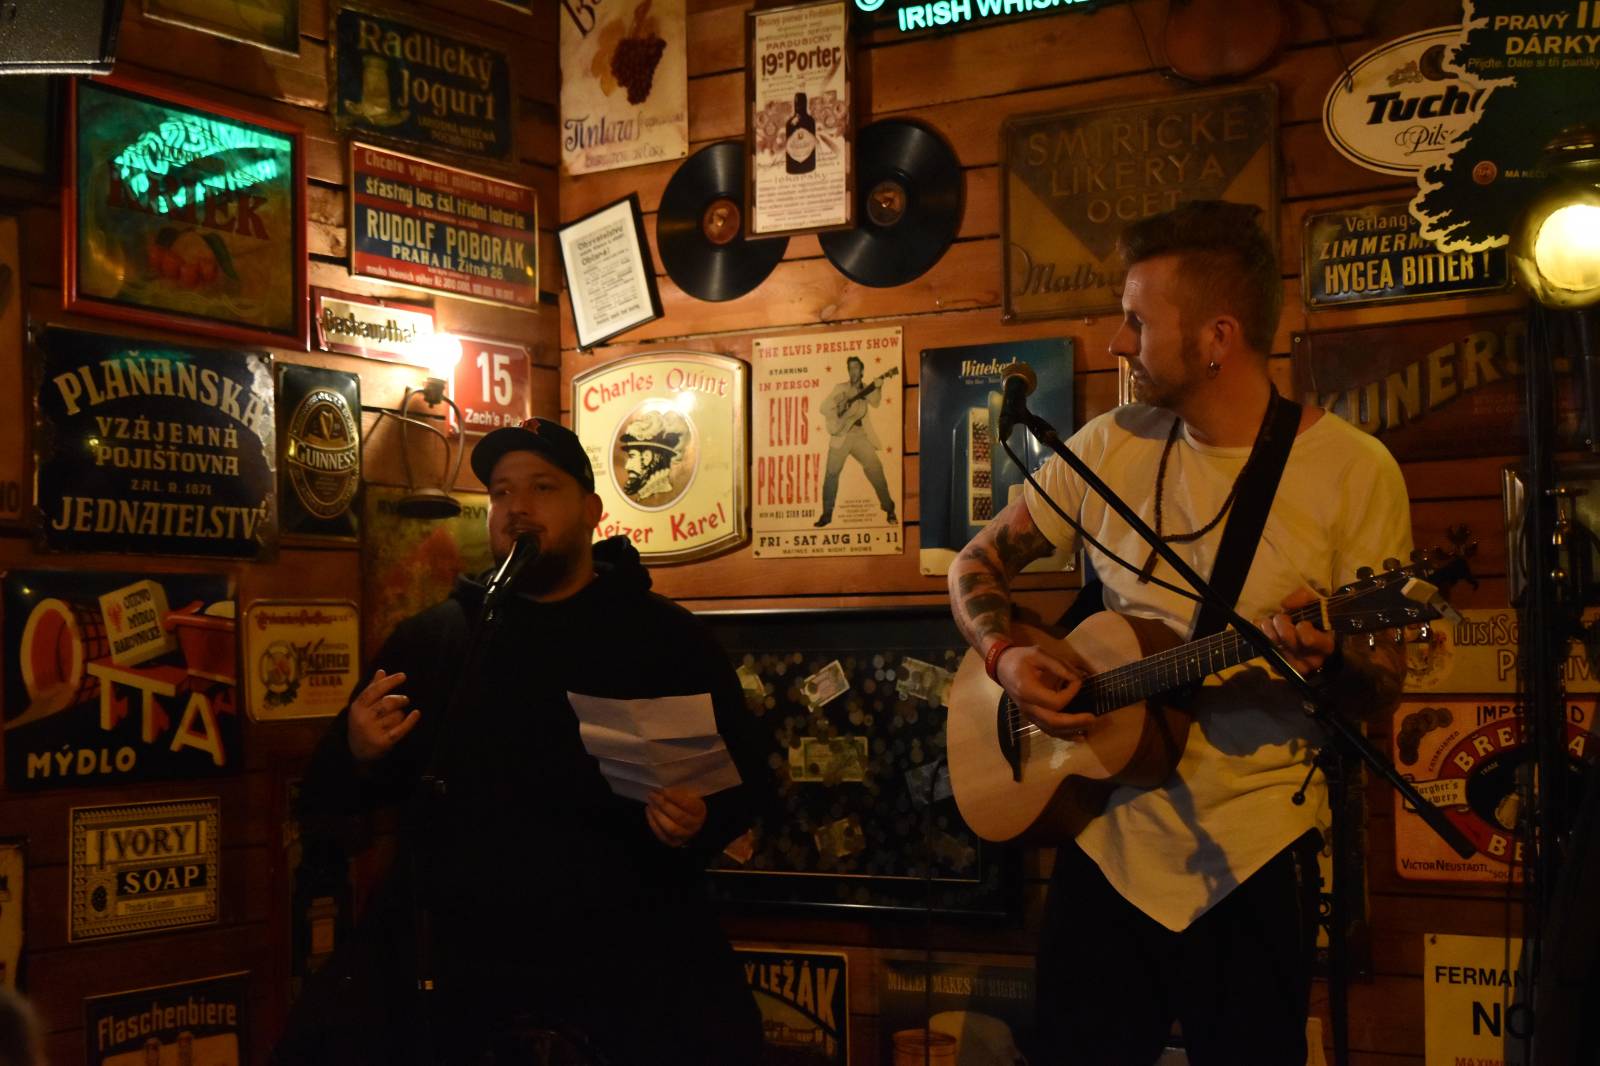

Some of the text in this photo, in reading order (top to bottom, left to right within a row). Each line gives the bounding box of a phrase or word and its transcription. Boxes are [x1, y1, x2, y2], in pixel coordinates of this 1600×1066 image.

[899, 0, 972, 31] IRISH
[1494, 11, 1569, 31] PRAVÝ
[358, 18, 495, 89] Radlický
[1505, 32, 1600, 55] DÁRKY
[786, 46, 840, 73] Porter
[1200, 153, 1225, 181] A
[416, 188, 434, 208] los
[366, 208, 436, 250] RUDOLF
[391, 244, 440, 268] PRAHA
[1324, 258, 1395, 295] HYGEA
[758, 337, 900, 358] THE ELVIS PRESLEY SHOW
[476, 351, 513, 406] 15
[759, 378, 820, 392] IN PERSON
[769, 367, 809, 376] STARRING
[583, 368, 728, 412] Charles Quint
[95, 414, 239, 449] VZÁJEMNÁ
[464, 408, 500, 426] Zach's
[769, 396, 809, 447] ELVIS
[95, 444, 240, 477] POJIŠŤOVNA
[295, 442, 357, 471] GUINNESS
[758, 453, 820, 506] PRESLEY
[669, 502, 727, 542] Karel
[759, 536, 781, 547] FRI
[793, 534, 818, 546] SAT
[822, 533, 851, 545] AUG
[857, 533, 871, 544] 10
[886, 532, 898, 543] 11
[18, 597, 227, 767] OTTA
[25, 743, 137, 779] MÝDLO
[97, 824, 194, 870] IVORY
[123, 865, 201, 895] SOAP
[932, 974, 972, 995] MAKES
[97, 995, 237, 1052] Flaschenbiere
